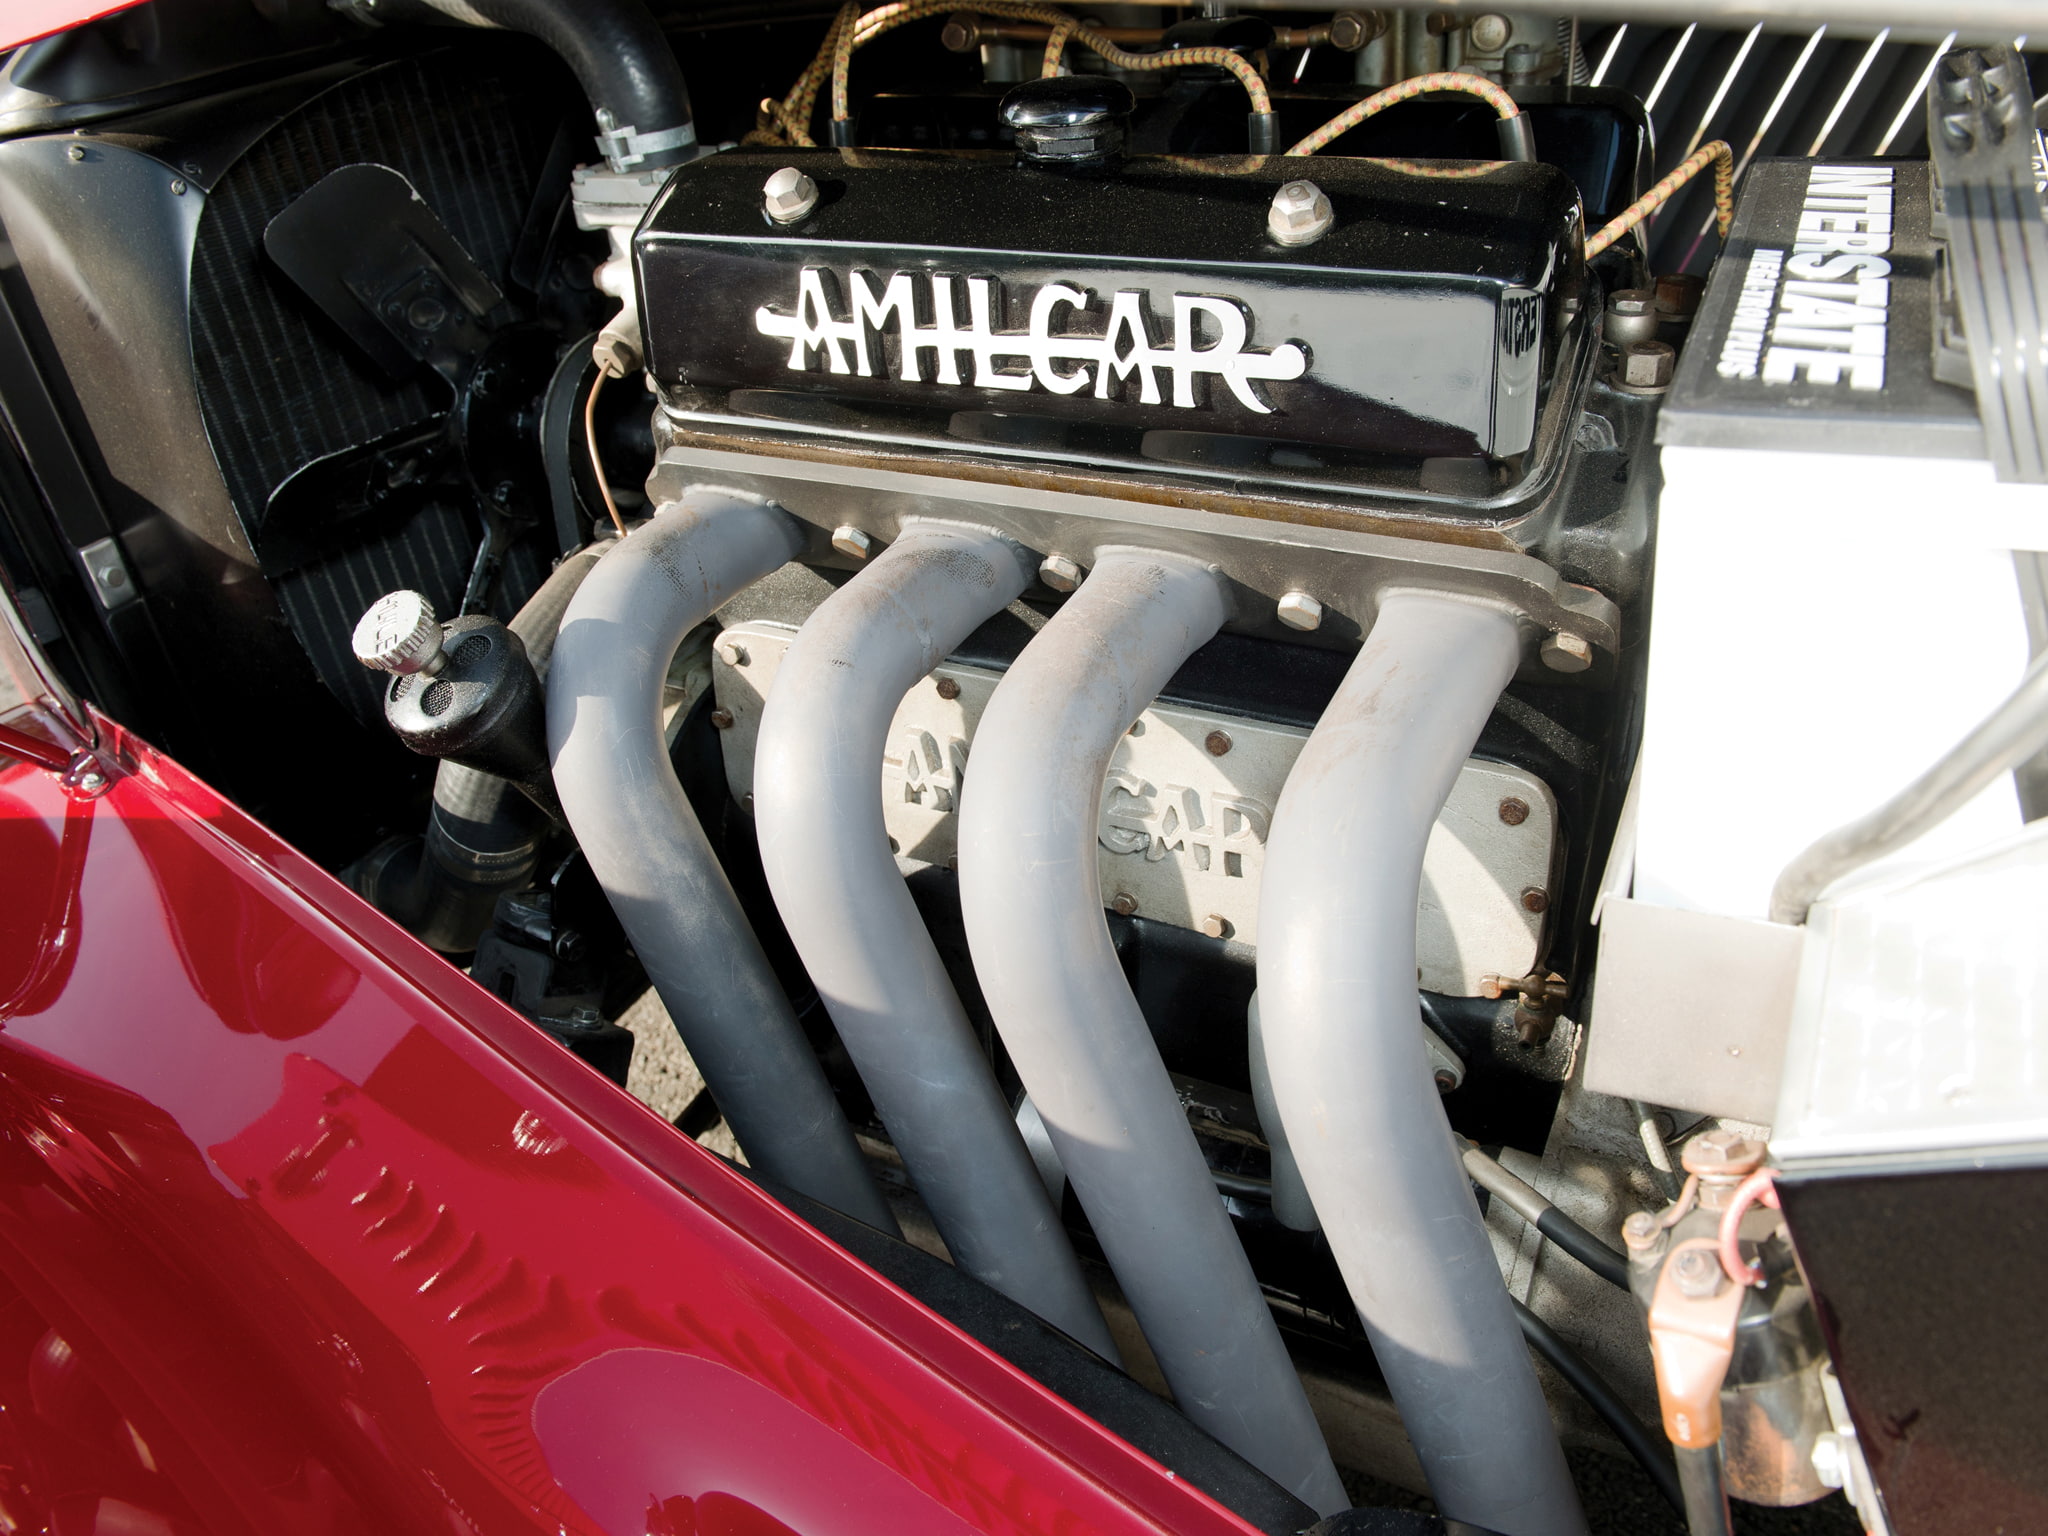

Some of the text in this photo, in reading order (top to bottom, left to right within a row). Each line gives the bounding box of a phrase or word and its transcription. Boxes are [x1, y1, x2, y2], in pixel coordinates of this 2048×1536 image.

[756, 266, 1308, 415] AMILCAR
[1762, 165, 1893, 391] INTERSTATE
[1716, 331, 1766, 379] PLUS
